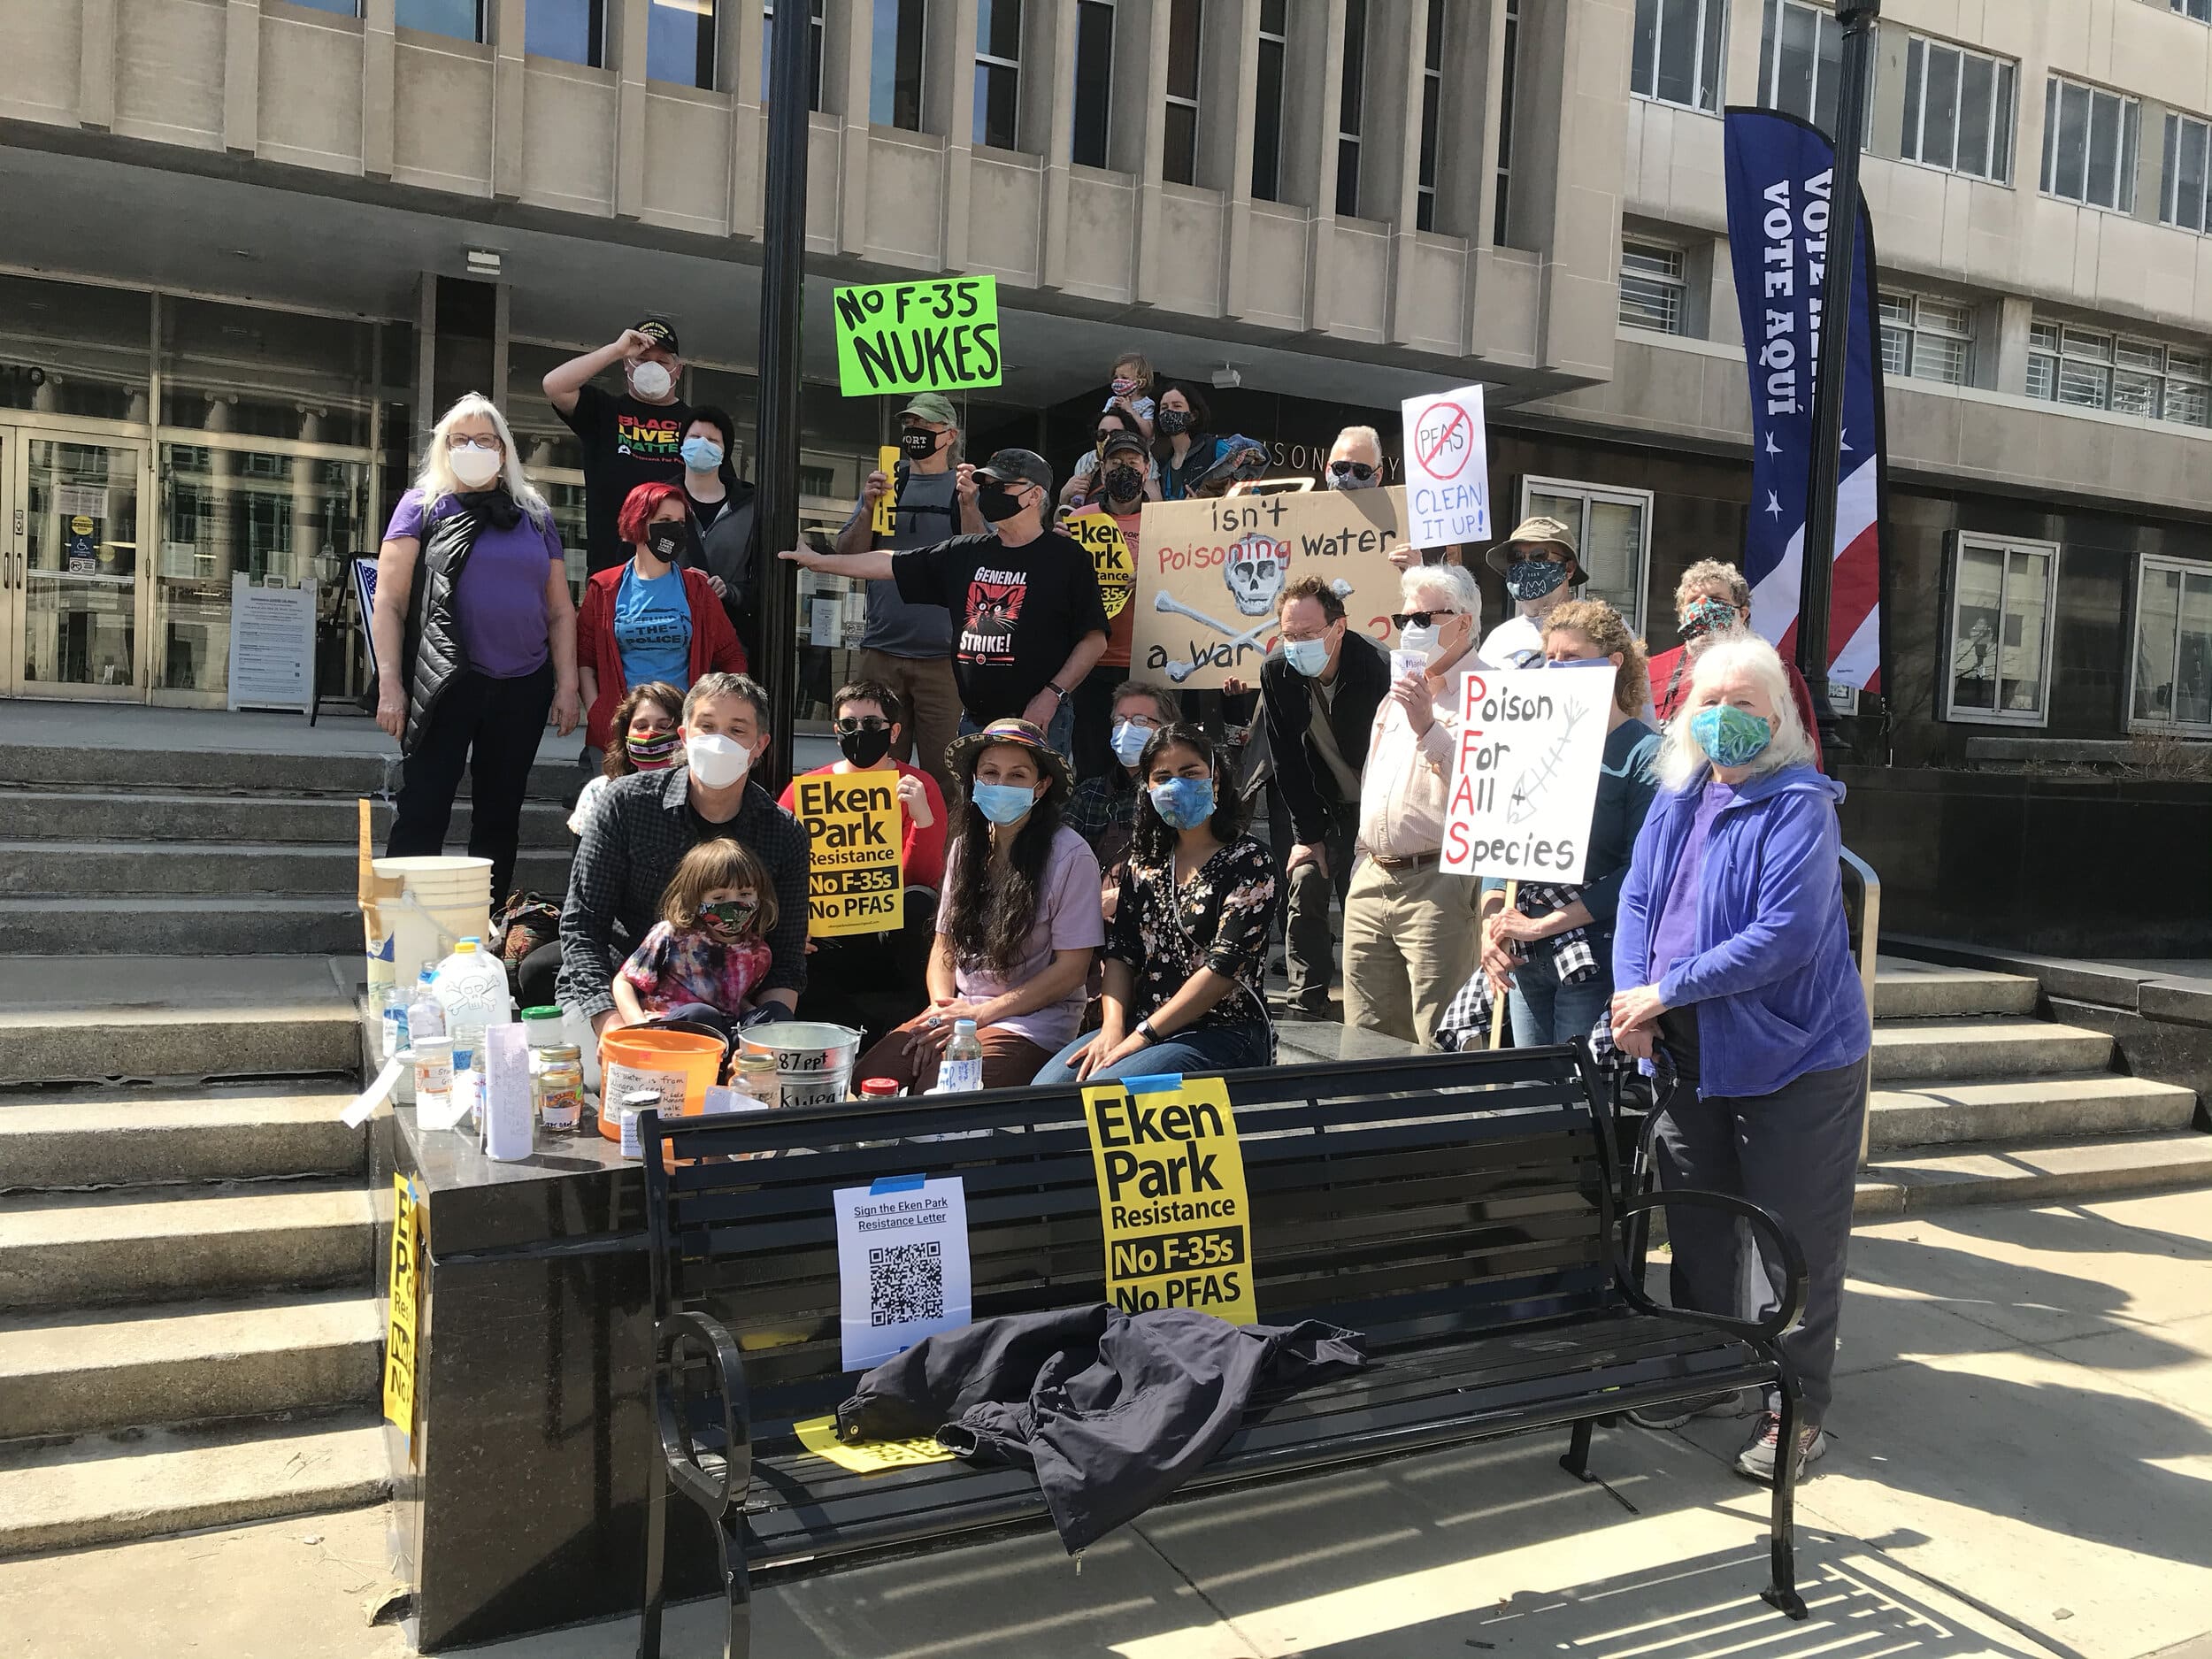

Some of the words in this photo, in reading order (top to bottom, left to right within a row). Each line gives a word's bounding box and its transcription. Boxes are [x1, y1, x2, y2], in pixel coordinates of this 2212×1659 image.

[1763, 180, 1793, 297] VOTE
[836, 289, 883, 331] NO
[896, 282, 979, 324] F-35
[853, 324, 997, 388] NUKES
[1759, 309, 1804, 415] AQUÍ
[618, 414, 681, 431] BLAC
[618, 434, 679, 454] MATTE
[902, 435, 926, 445] ORT
[1420, 423, 1463, 458] PFAS
[1263, 442, 1325, 472] SON
[1212, 497, 1288, 532] isn't
[1416, 482, 1483, 515] CLEAN
[1423, 518, 1445, 541] IT
[1452, 509, 1484, 535] UP!
[1091, 548, 1123, 569] rk
[974, 566, 1027, 586] GENERAL
[1101, 587, 1126, 601] 35s
[626, 635, 681, 644] POLICE
[959, 631, 1012, 653] STRIKE!
[1147, 644, 1168, 670] a
[1190, 641, 1253, 669] war
[1465, 675, 1554, 722] Poison
[1460, 729, 1511, 774] For
[800, 781, 893, 816] Eken
[1450, 774, 1495, 816] All
[803, 812, 887, 849] Park
[809, 849, 895, 866] Resistance
[1446, 821, 1575, 873] Species
[809, 874, 839, 895] No
[841, 870, 893, 893] F-35s
[809, 900, 840, 920] No
[844, 894, 895, 918] PFAS
[804, 1052, 828, 1071] ppt
[1094, 1094, 1225, 1148] Eken
[1104, 1141, 1224, 1202] Park
[854, 1205, 877, 1217] Sign
[879, 1203, 896, 1212] the
[898, 1201, 923, 1210] Eken
[925, 1197, 948, 1208] Park
[858, 1217, 914, 1231] Resistance
[917, 1213, 947, 1224] Letter
[1111, 1198, 1235, 1230] Resistance
[1114, 1243, 1158, 1276] No
[1163, 1234, 1234, 1270] F-35s
[1116, 1286, 1159, 1313] No
[1166, 1271, 1241, 1310] PFAS
